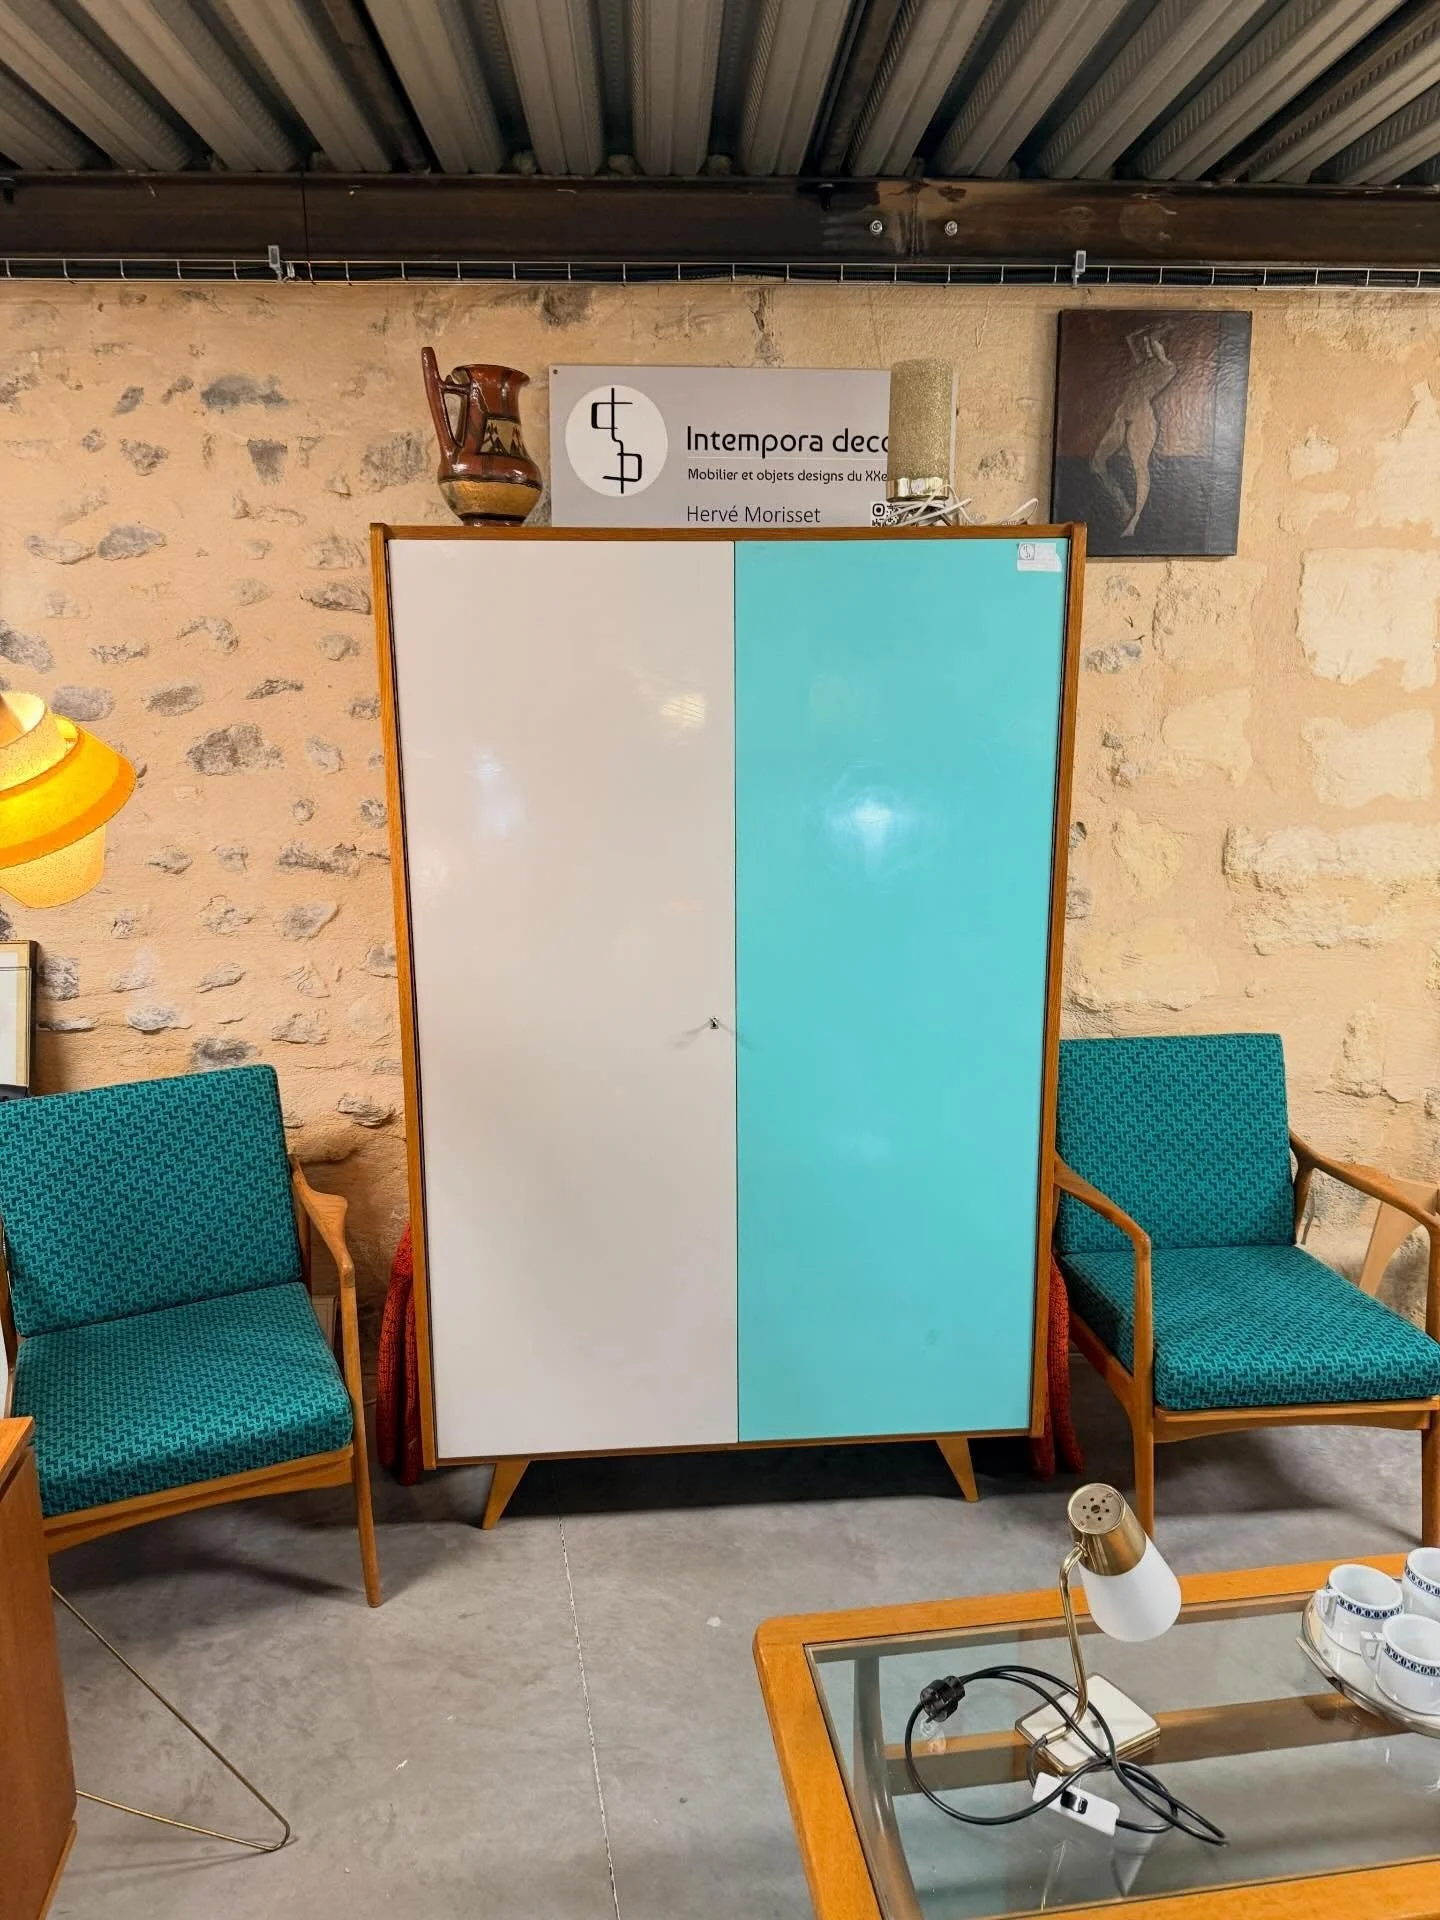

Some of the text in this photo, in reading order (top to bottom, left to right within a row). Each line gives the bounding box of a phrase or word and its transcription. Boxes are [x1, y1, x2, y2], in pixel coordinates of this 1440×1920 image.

[687, 425, 823, 459] Intempora
[687, 468, 888, 485] Mobilier et objets designs du XXe
[687, 505, 821, 523] Hervé Morisset
